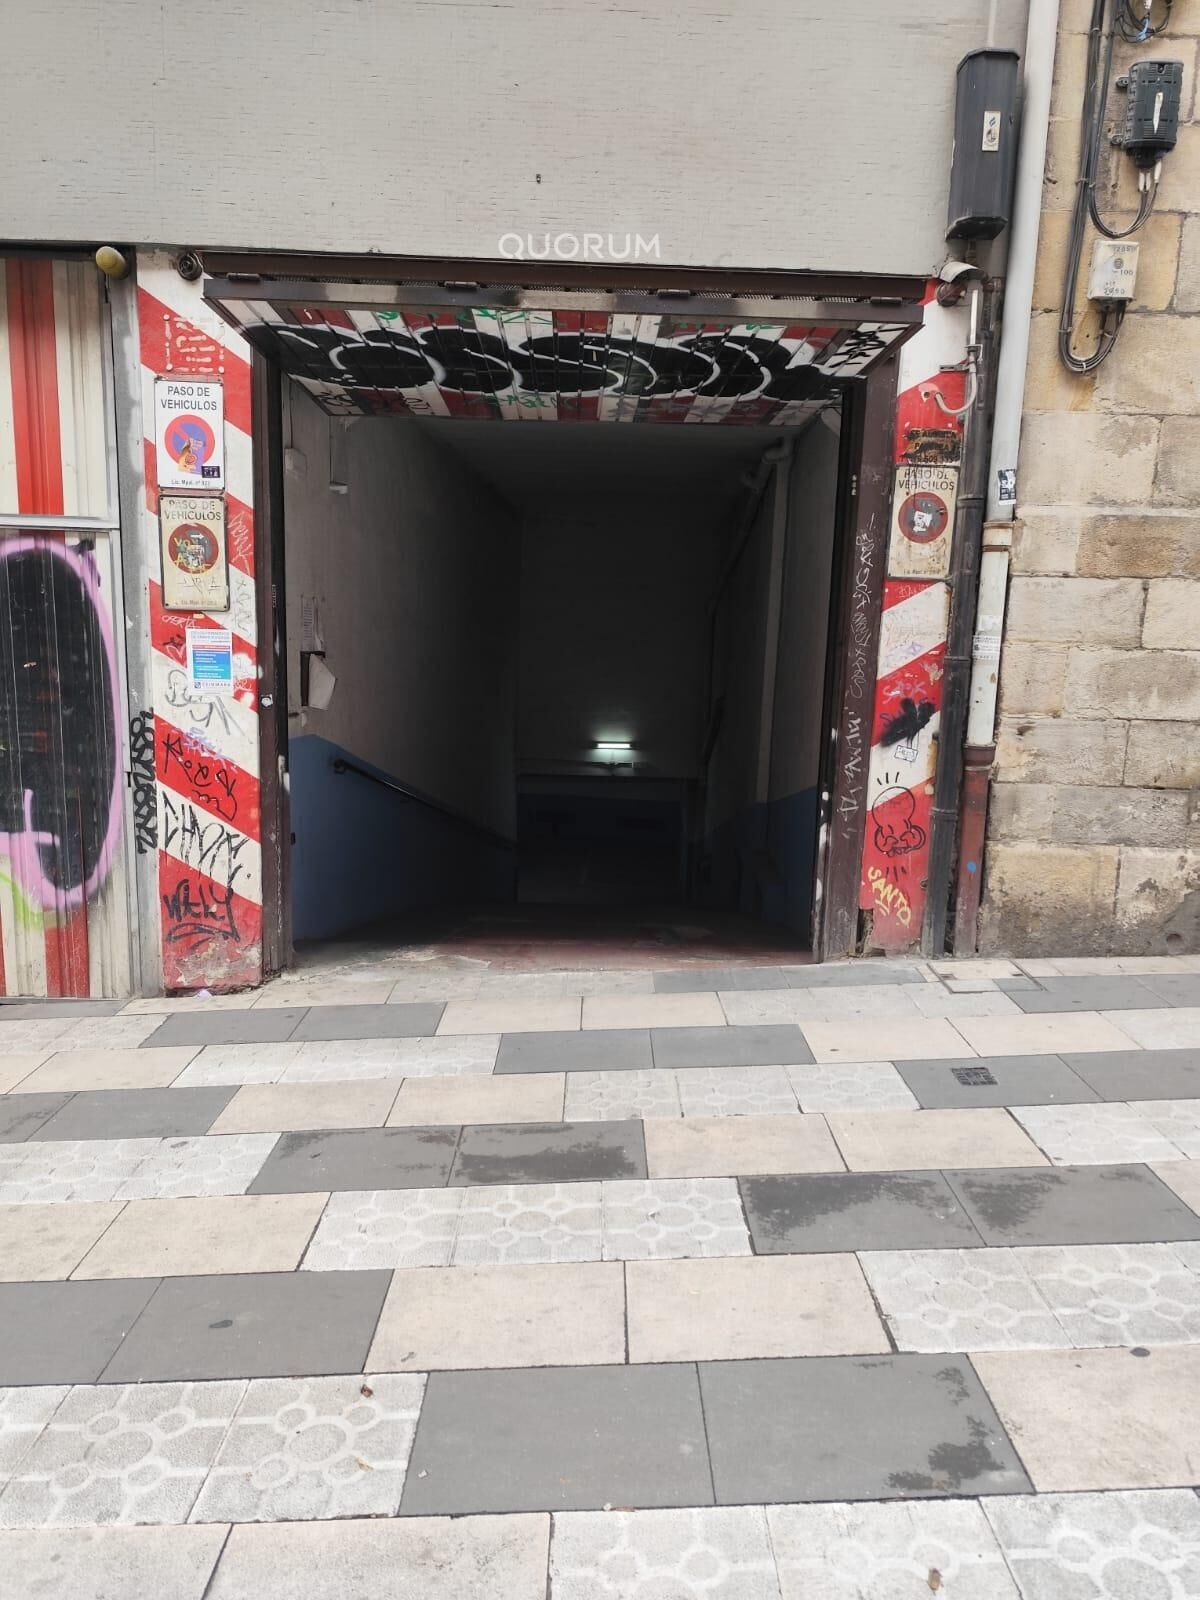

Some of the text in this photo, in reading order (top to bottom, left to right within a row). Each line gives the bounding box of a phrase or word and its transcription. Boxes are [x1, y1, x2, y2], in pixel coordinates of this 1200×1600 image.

[167, 386, 210, 397] PASO DE
[161, 399, 217, 411] VEHICULOS
[164, 511, 222, 521] VEHICULOS
